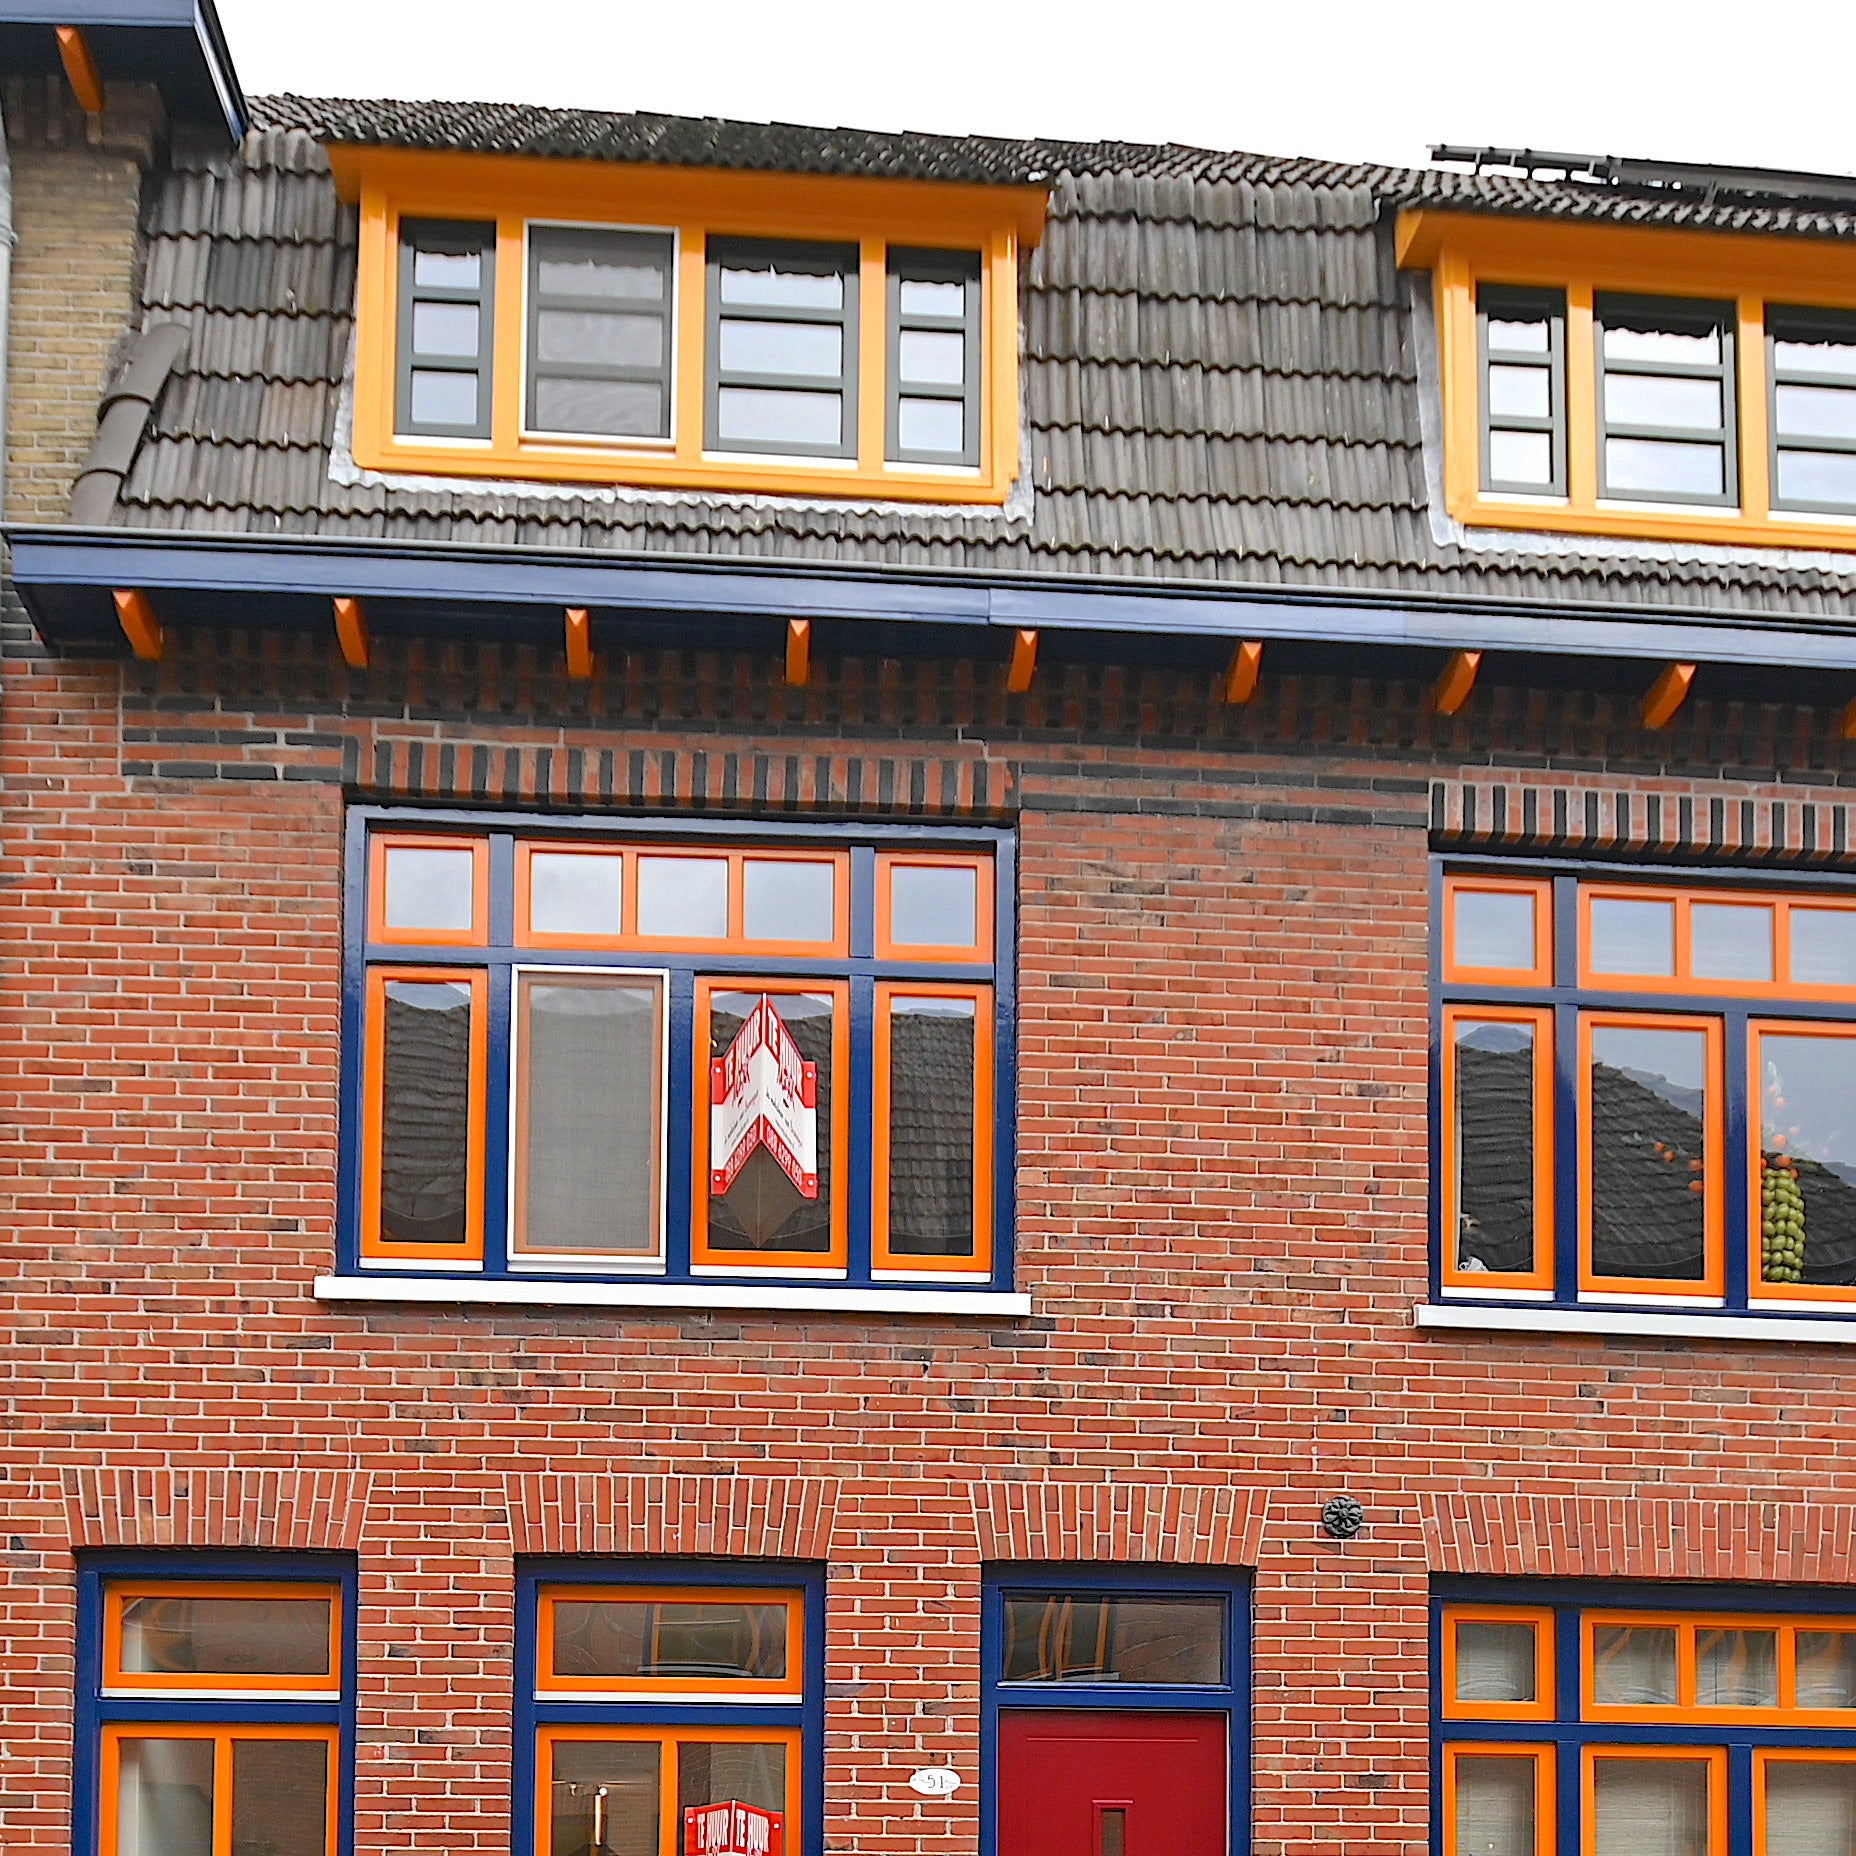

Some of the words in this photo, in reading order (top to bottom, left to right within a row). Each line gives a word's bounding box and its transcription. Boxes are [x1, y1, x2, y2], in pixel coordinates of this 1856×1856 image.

[725, 1047, 734, 1093] TE
[735, 1008, 761, 1076] HUUR
[768, 1006, 779, 1058] TE
[779, 1027, 804, 1098] HUUR
[927, 1774, 944, 1789] 51
[697, 1812, 706, 1849] TE
[706, 1809, 729, 1849] HUUR
[736, 1809, 746, 1847] TE
[747, 1812, 770, 1852] HUUR
